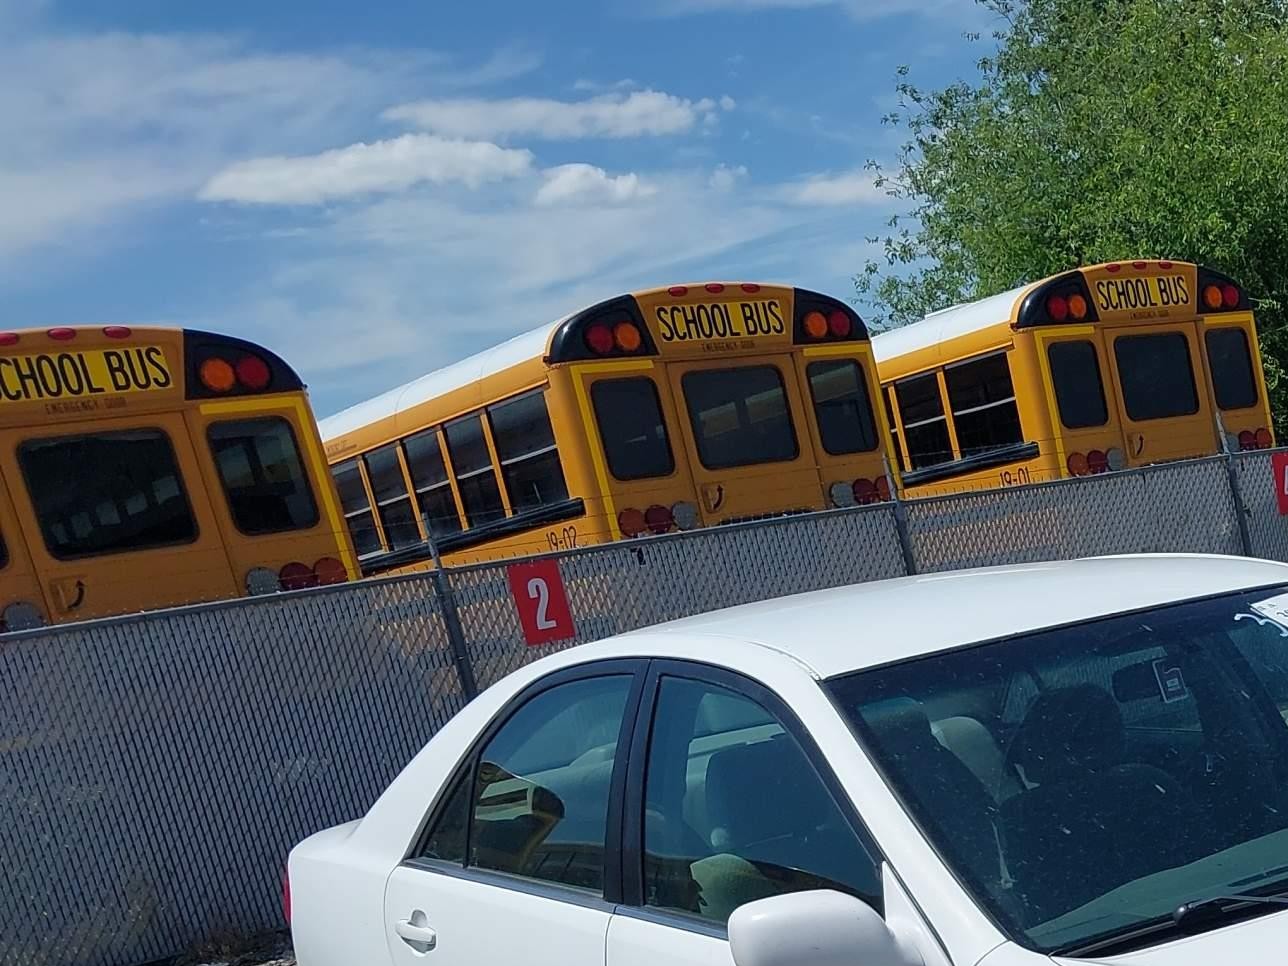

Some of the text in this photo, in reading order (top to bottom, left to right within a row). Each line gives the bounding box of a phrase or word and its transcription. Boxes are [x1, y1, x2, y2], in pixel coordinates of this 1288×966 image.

[1096, 276, 1189, 310] SCHOOL BUS
[656, 300, 784, 341] SCHOOL BUS
[0, 346, 171, 401] CHOOL BUS
[527, 577, 558, 631] 2
